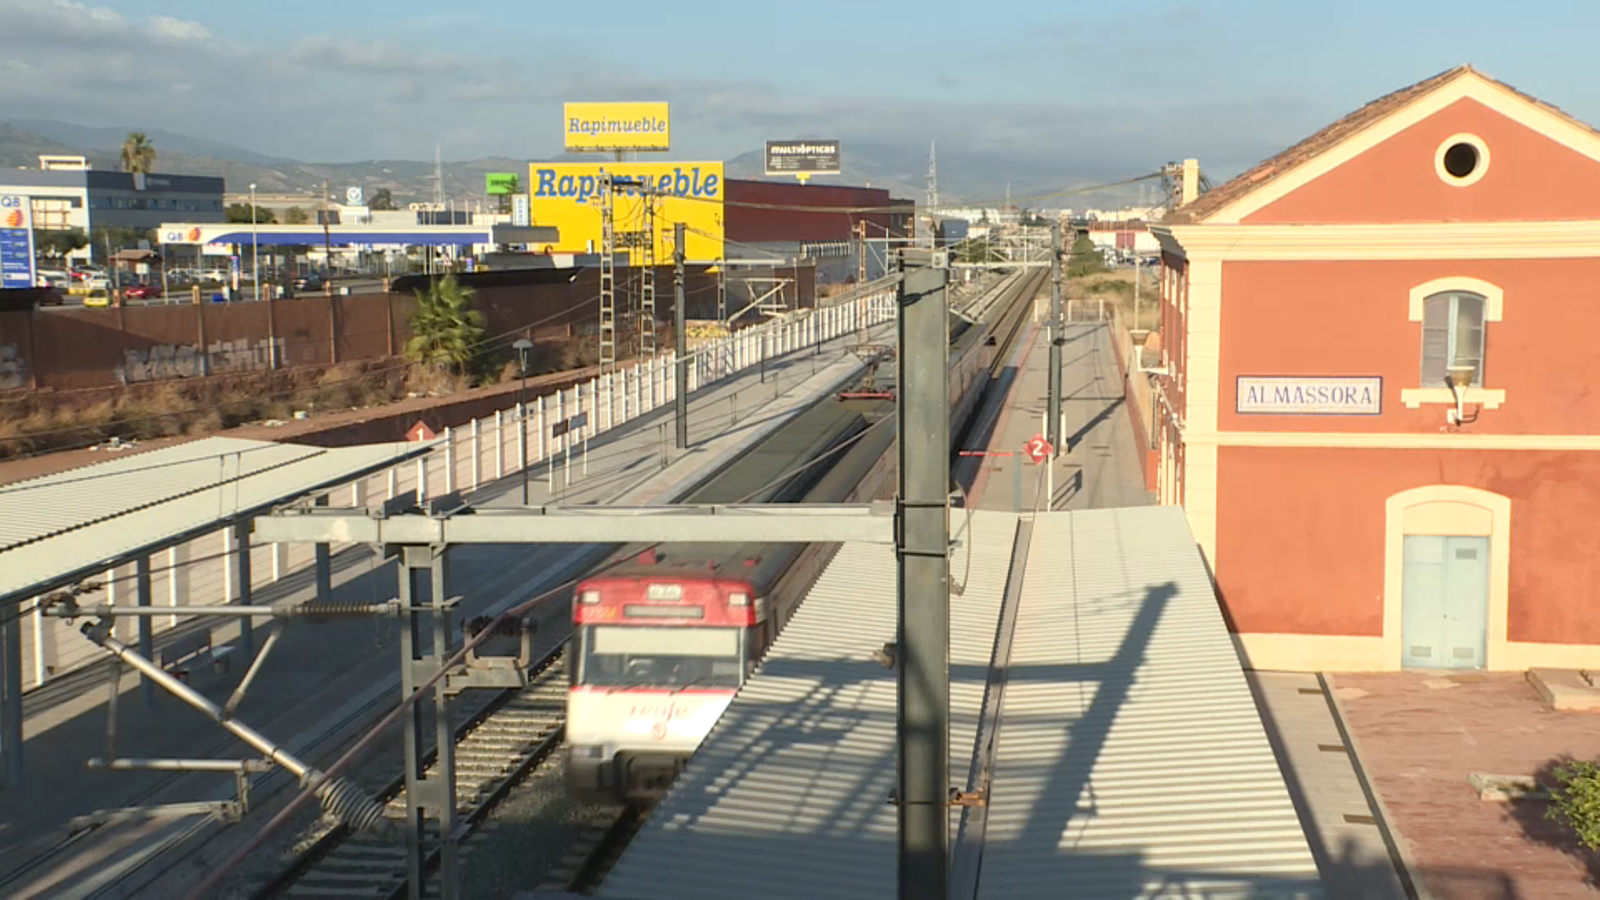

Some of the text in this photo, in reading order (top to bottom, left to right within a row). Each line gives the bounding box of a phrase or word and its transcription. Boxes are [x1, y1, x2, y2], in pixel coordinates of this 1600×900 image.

[569, 116, 666, 136] Rapimueble
[1, 196, 21, 207] Q8
[167, 231, 184, 241] Q8
[1247, 386, 1372, 404] ALMASSORA
[416, 428, 424, 441] 1
[1032, 440, 1043, 456] 2
